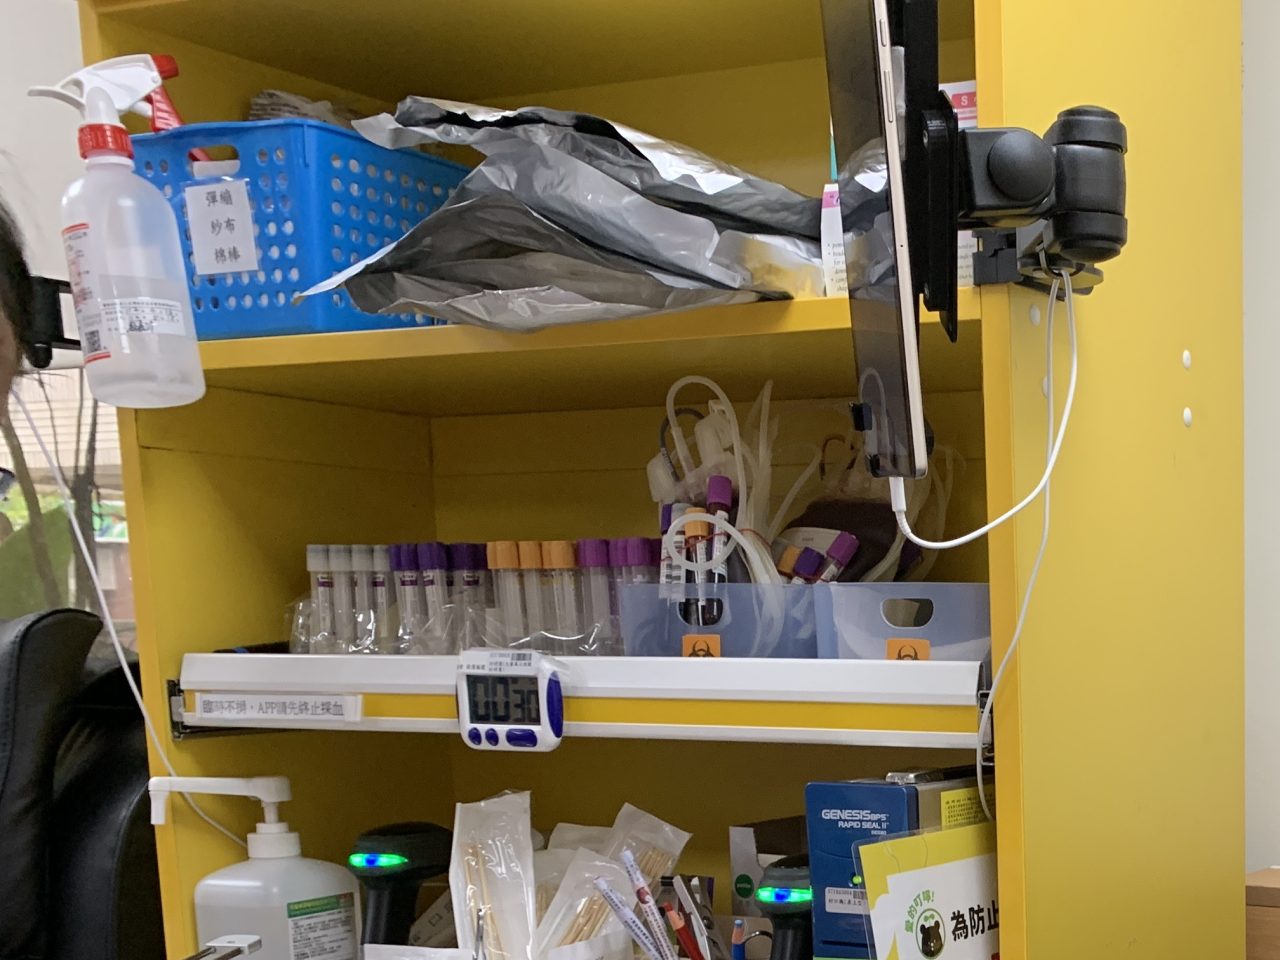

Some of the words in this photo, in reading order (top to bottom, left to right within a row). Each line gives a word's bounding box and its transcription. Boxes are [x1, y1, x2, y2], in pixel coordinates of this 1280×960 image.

[838, 821, 861, 829] RAPID
[862, 821, 881, 829] SEAL
[950, 900, 999, 941] 為防止
